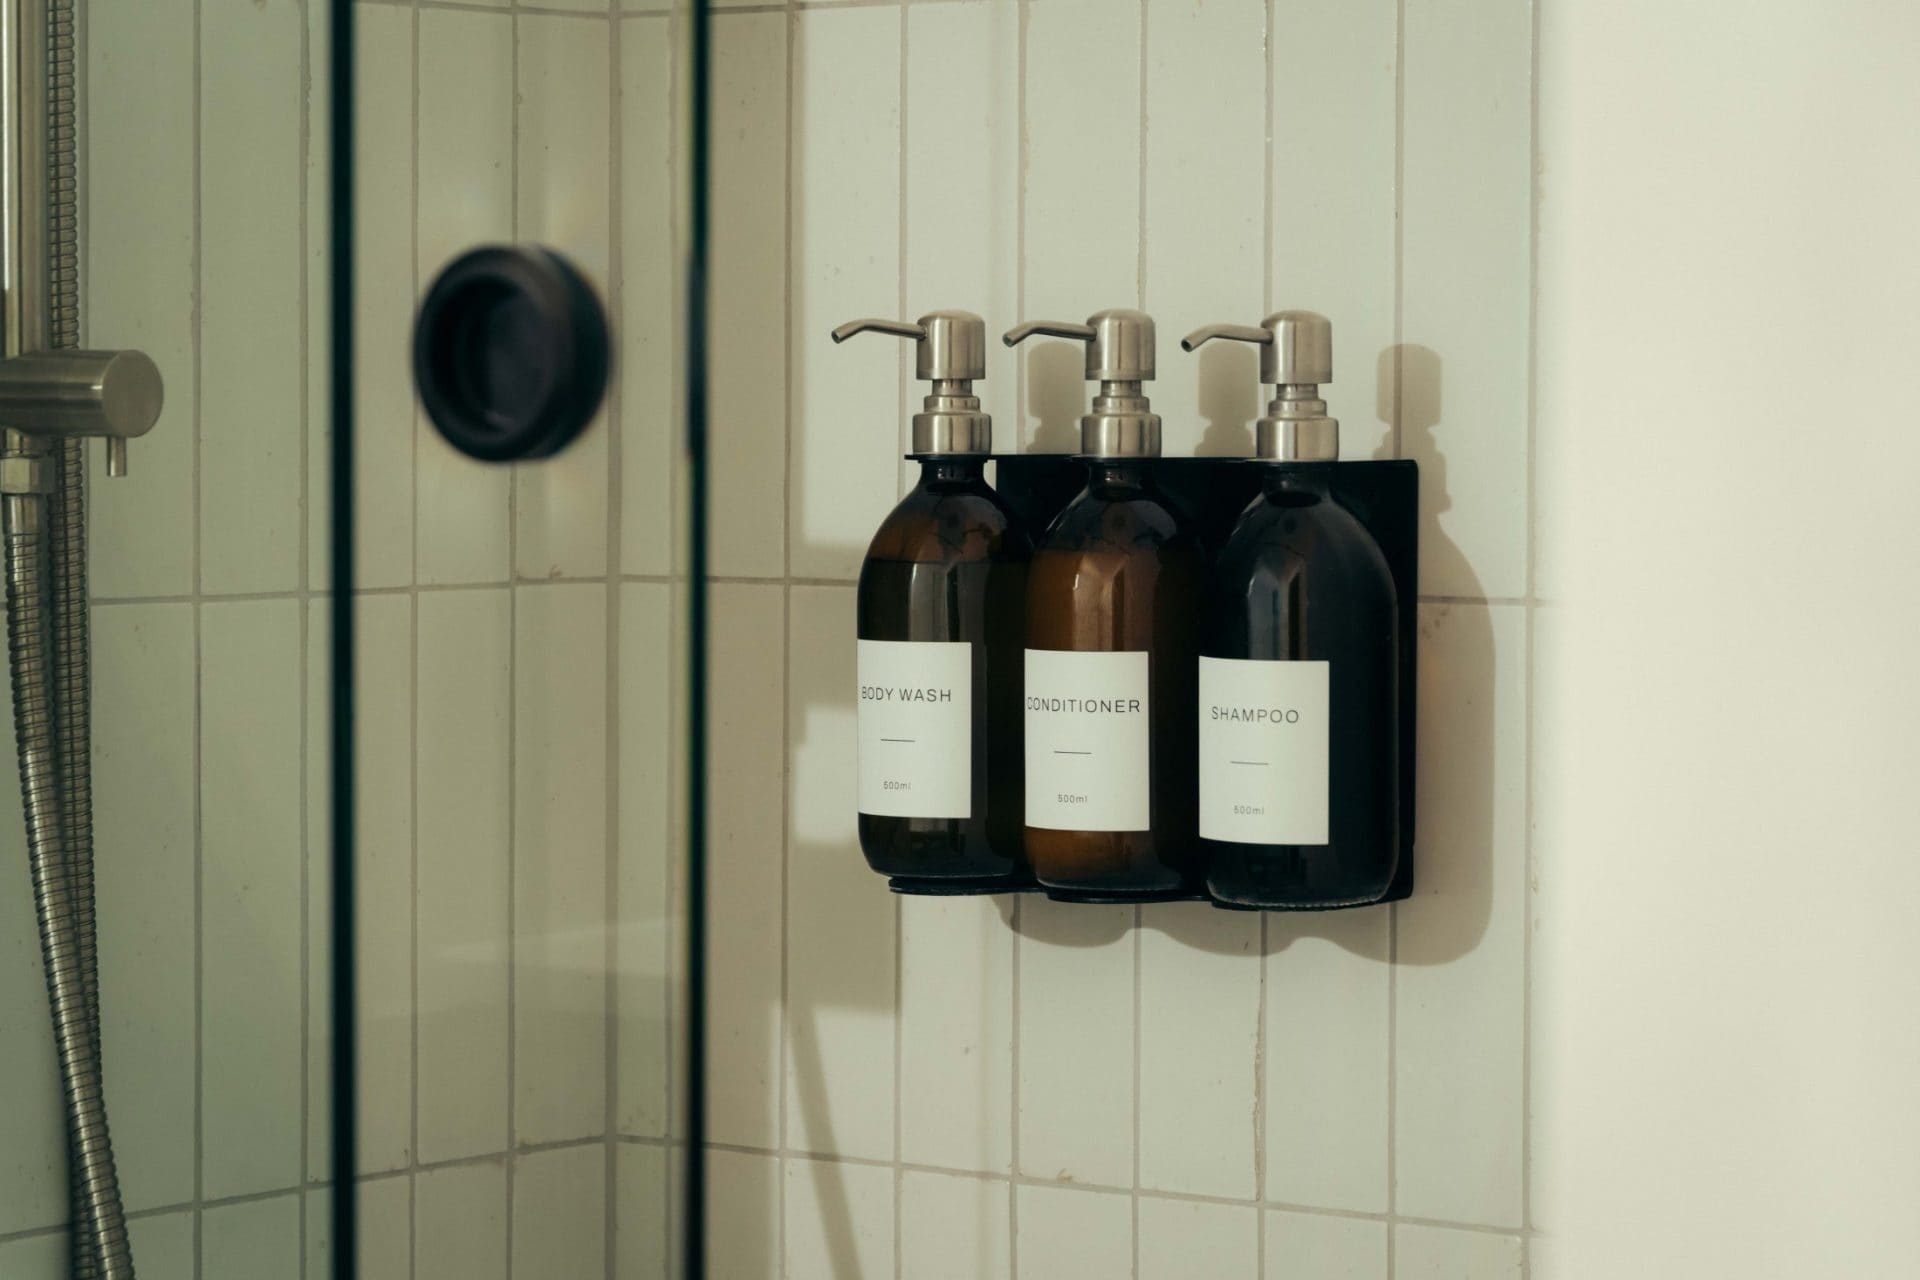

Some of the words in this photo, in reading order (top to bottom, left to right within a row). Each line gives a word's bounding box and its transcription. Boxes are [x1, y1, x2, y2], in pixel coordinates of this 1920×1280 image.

[861, 686, 894, 701] BODY
[899, 688, 952, 702] WASH
[1026, 696, 1141, 713] CONDITIONER
[1211, 706, 1300, 724] SHAMPOO
[883, 781, 912, 790] 500ml
[1057, 794, 1088, 803] 500ml
[1233, 805, 1265, 815] 500ml
